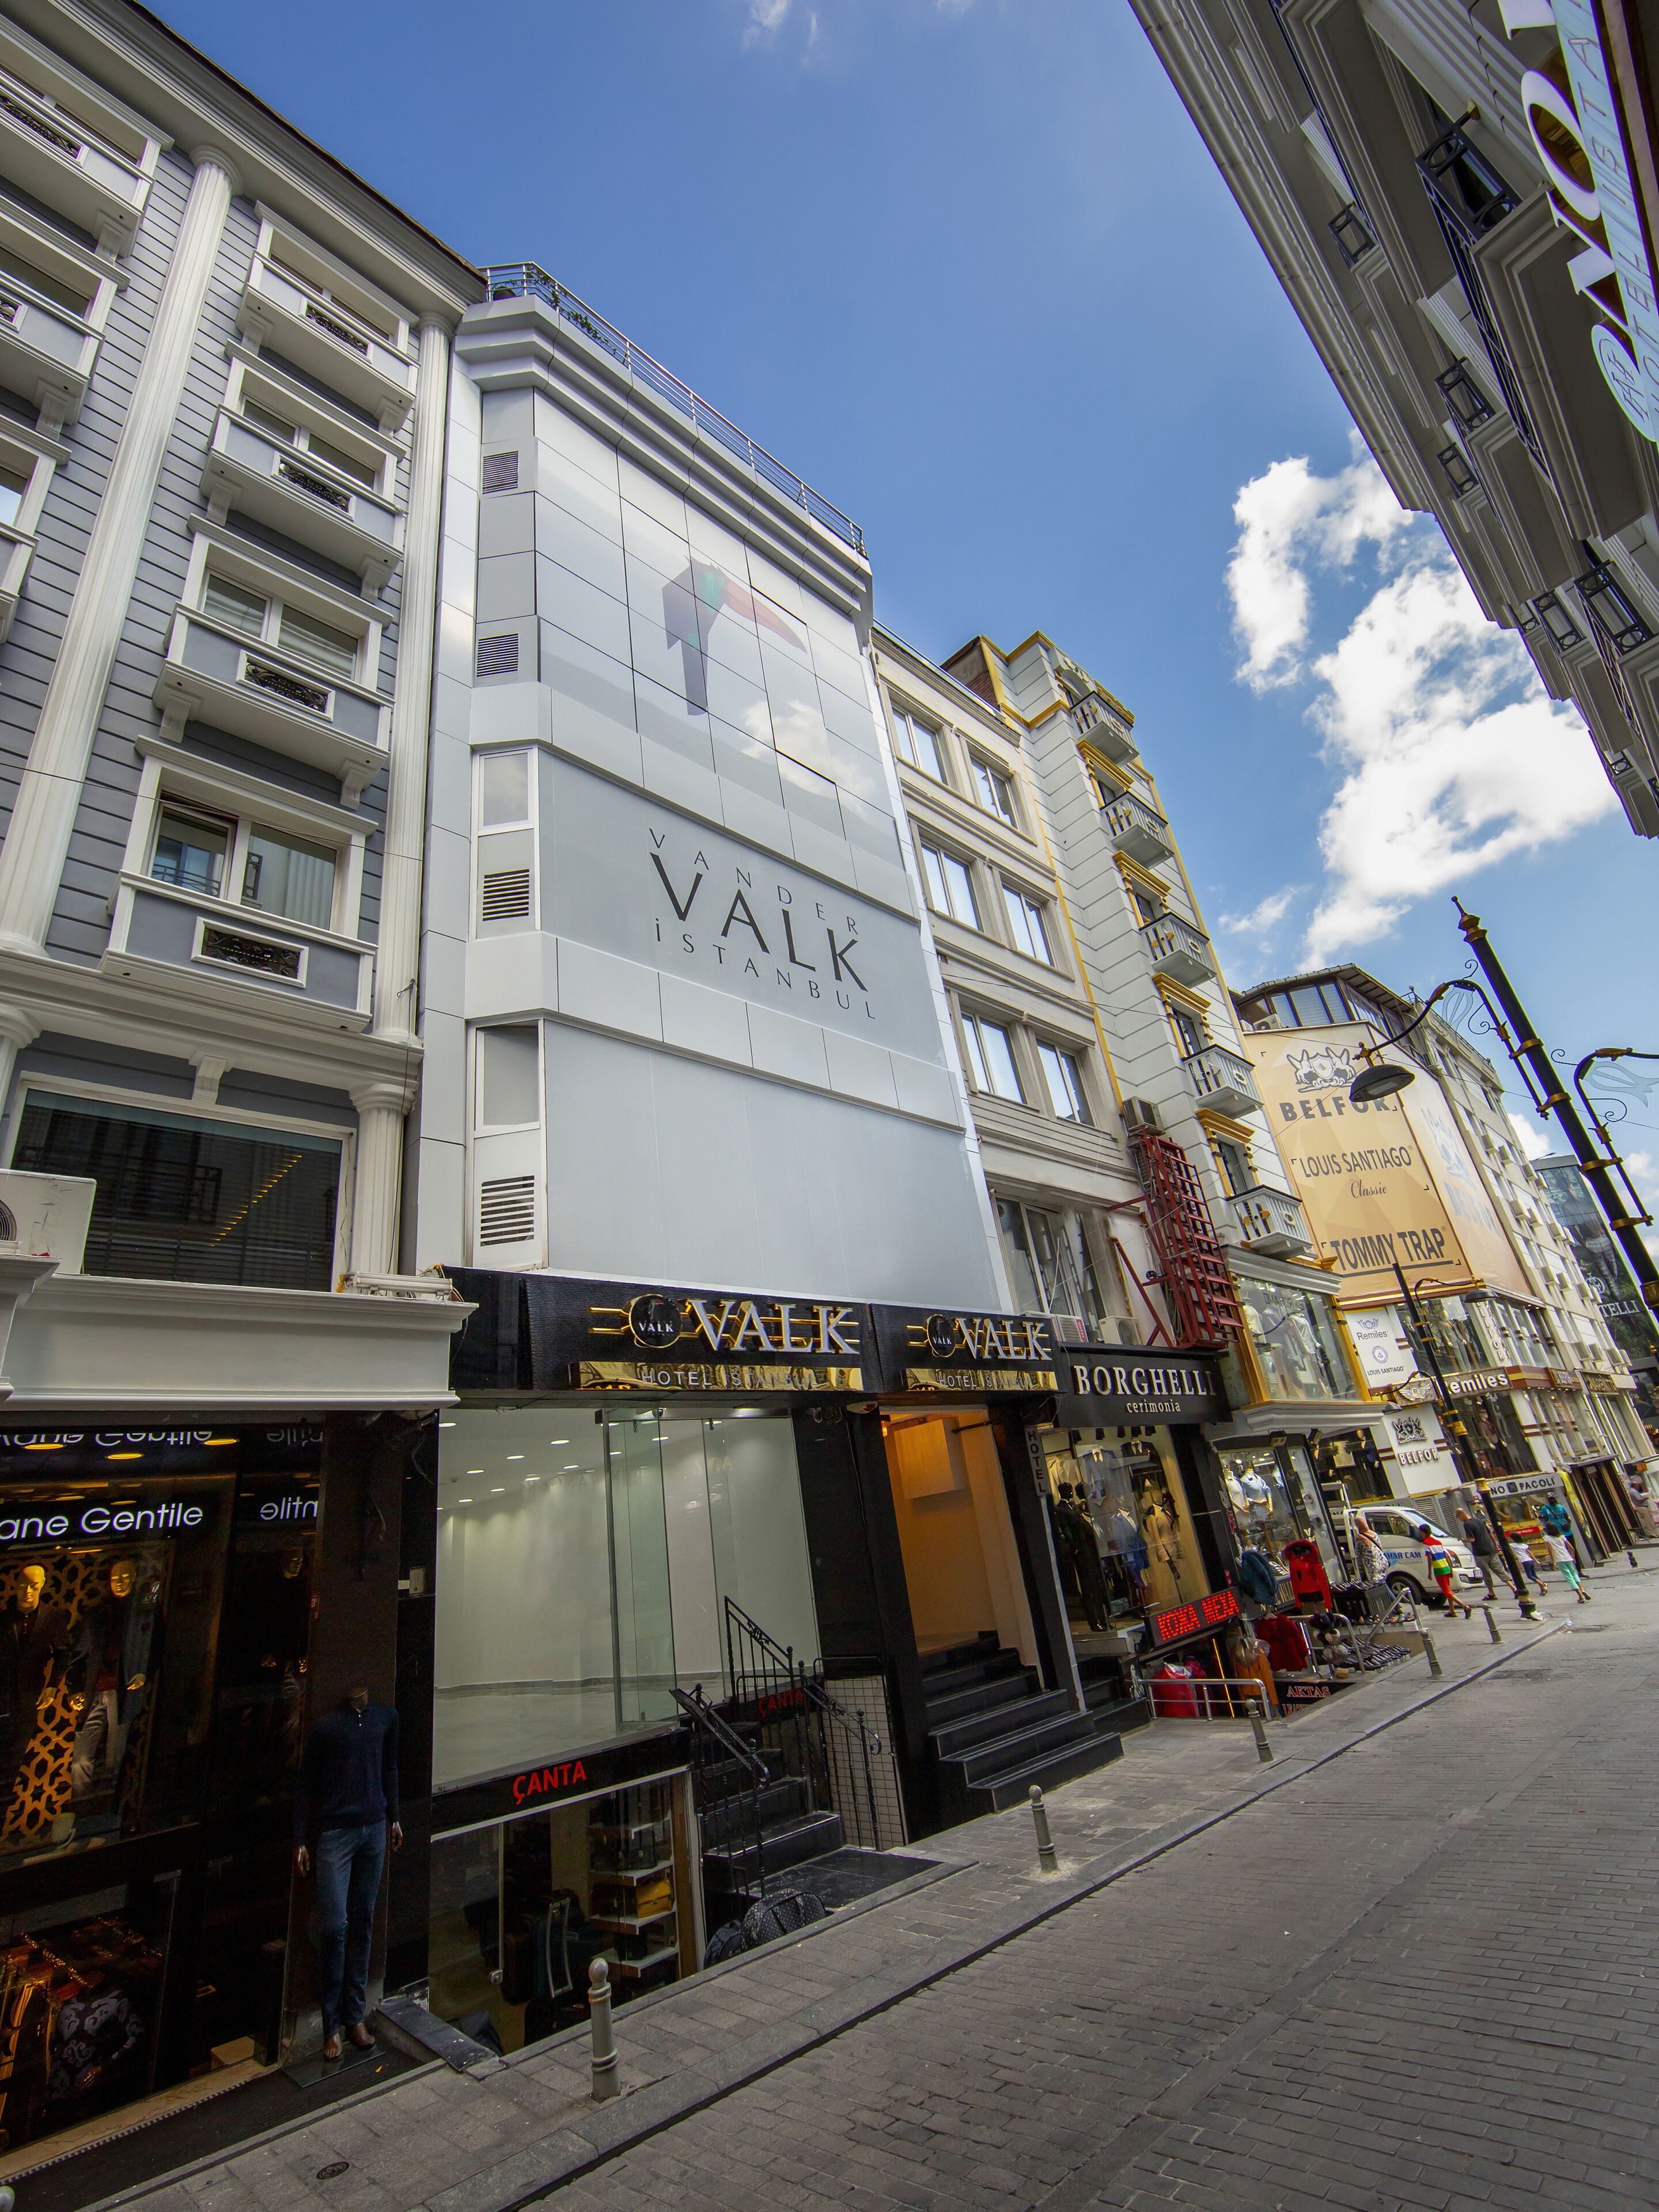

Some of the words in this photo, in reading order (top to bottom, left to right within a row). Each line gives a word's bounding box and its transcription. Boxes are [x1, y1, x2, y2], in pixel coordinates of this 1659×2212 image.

[1568, 0, 1627, 206] ISTA
[1618, 251, 1659, 416] OTEL
[649, 828, 858, 935] VANDER
[649, 851, 869, 993] VALK
[1299, 1153, 1342, 1178] LOUIS
[1341, 1146, 1412, 1173] SANTIAGO
[1350, 1179, 1387, 1199] Classic
[1330, 1233, 1399, 1271] TOMMY
[1398, 1227, 1445, 1262] TRAP
[638, 1321, 674, 1332] VALK
[685, 1298, 861, 1355] VALK
[932, 1336, 952, 1345] VALK
[955, 1317, 1053, 1361] VALK
[1357, 1330, 1388, 1340] Remiles
[641, 1370, 713, 1387] HOTEL
[938, 1375, 978, 1388] HOTEL
[1073, 1365, 1216, 1396] BORGHELLI
[1381, 1365, 1404, 1375] SANTIAGO
[1126, 1398, 1181, 1413] cerimonia
[1027, 1430, 1047, 1493] HOTEL
[1398, 1448, 1440, 1465] BELFOR
[1519, 1478, 1555, 1491] PACOLI
[81, 1503, 203, 1533] Gentile
[512, 1760, 587, 1805] ÇANTA
